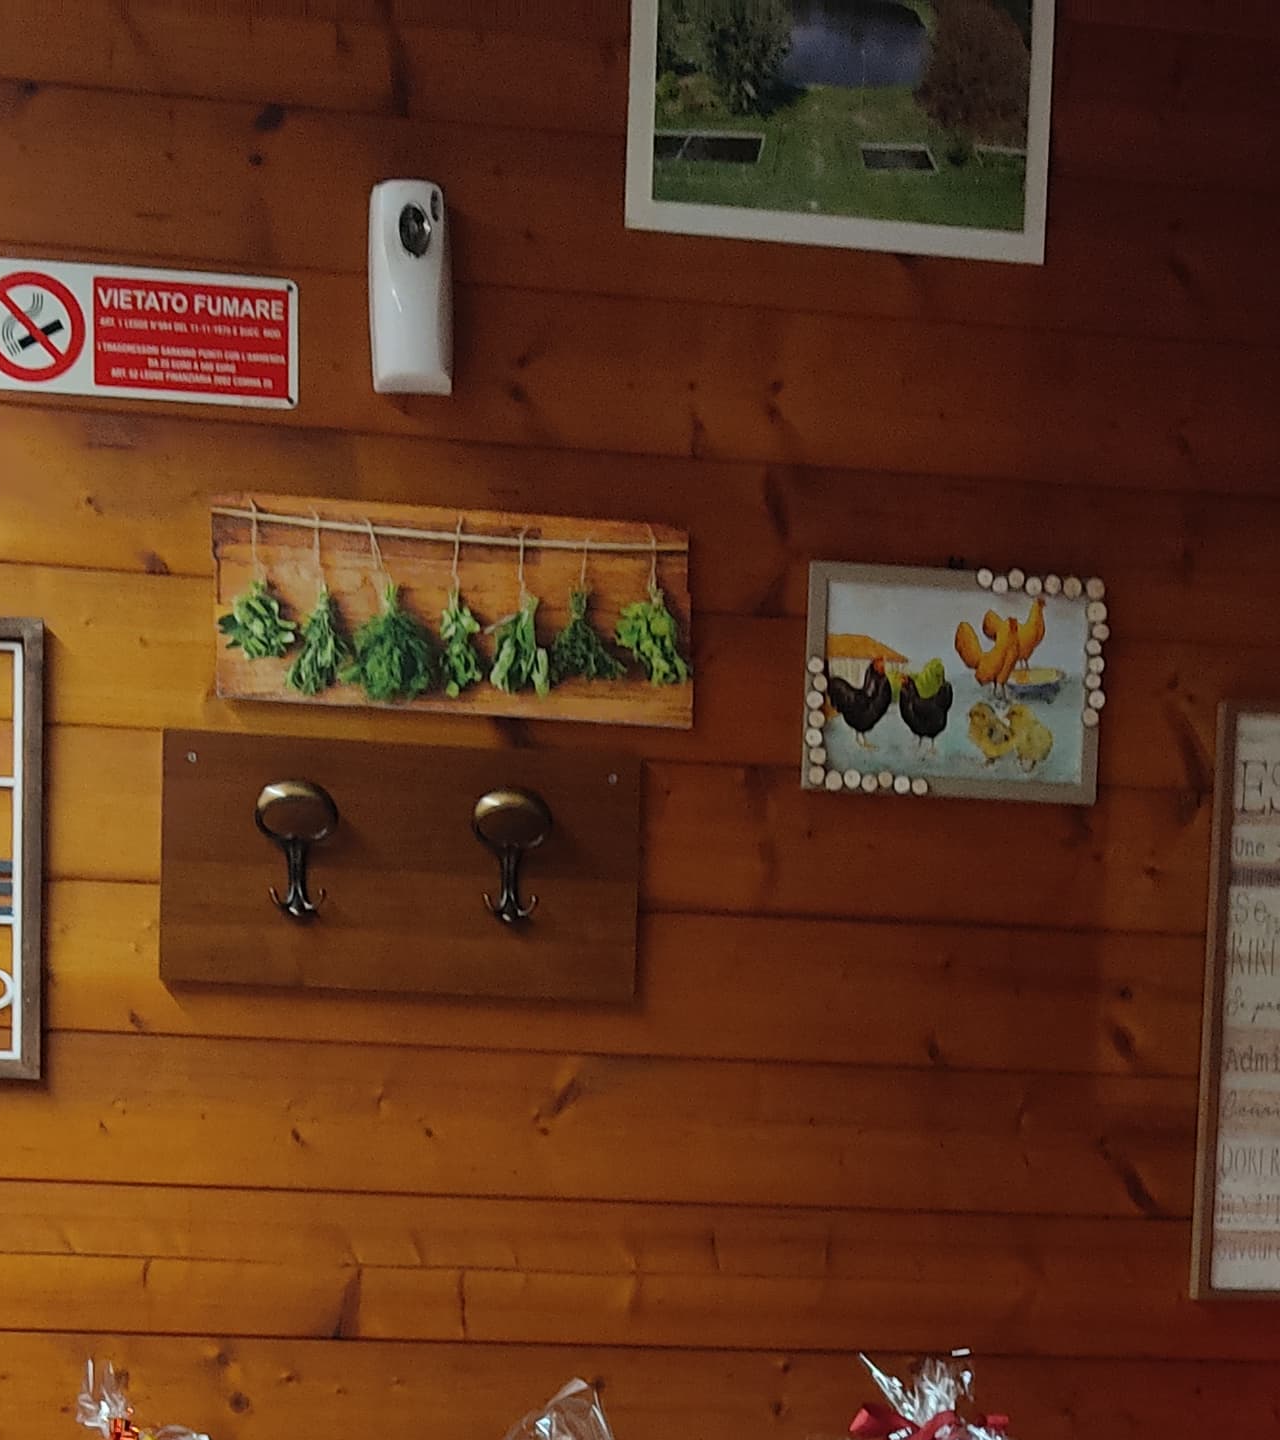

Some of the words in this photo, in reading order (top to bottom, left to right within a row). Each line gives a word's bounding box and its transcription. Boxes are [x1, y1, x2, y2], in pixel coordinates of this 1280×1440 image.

[97, 286, 189, 313] VIETATO
[193, 294, 285, 321] FUMARE
[1234, 837, 1265, 860] Une
[1233, 891, 1268, 924] Se
[1221, 1144, 1280, 1178] DORER
